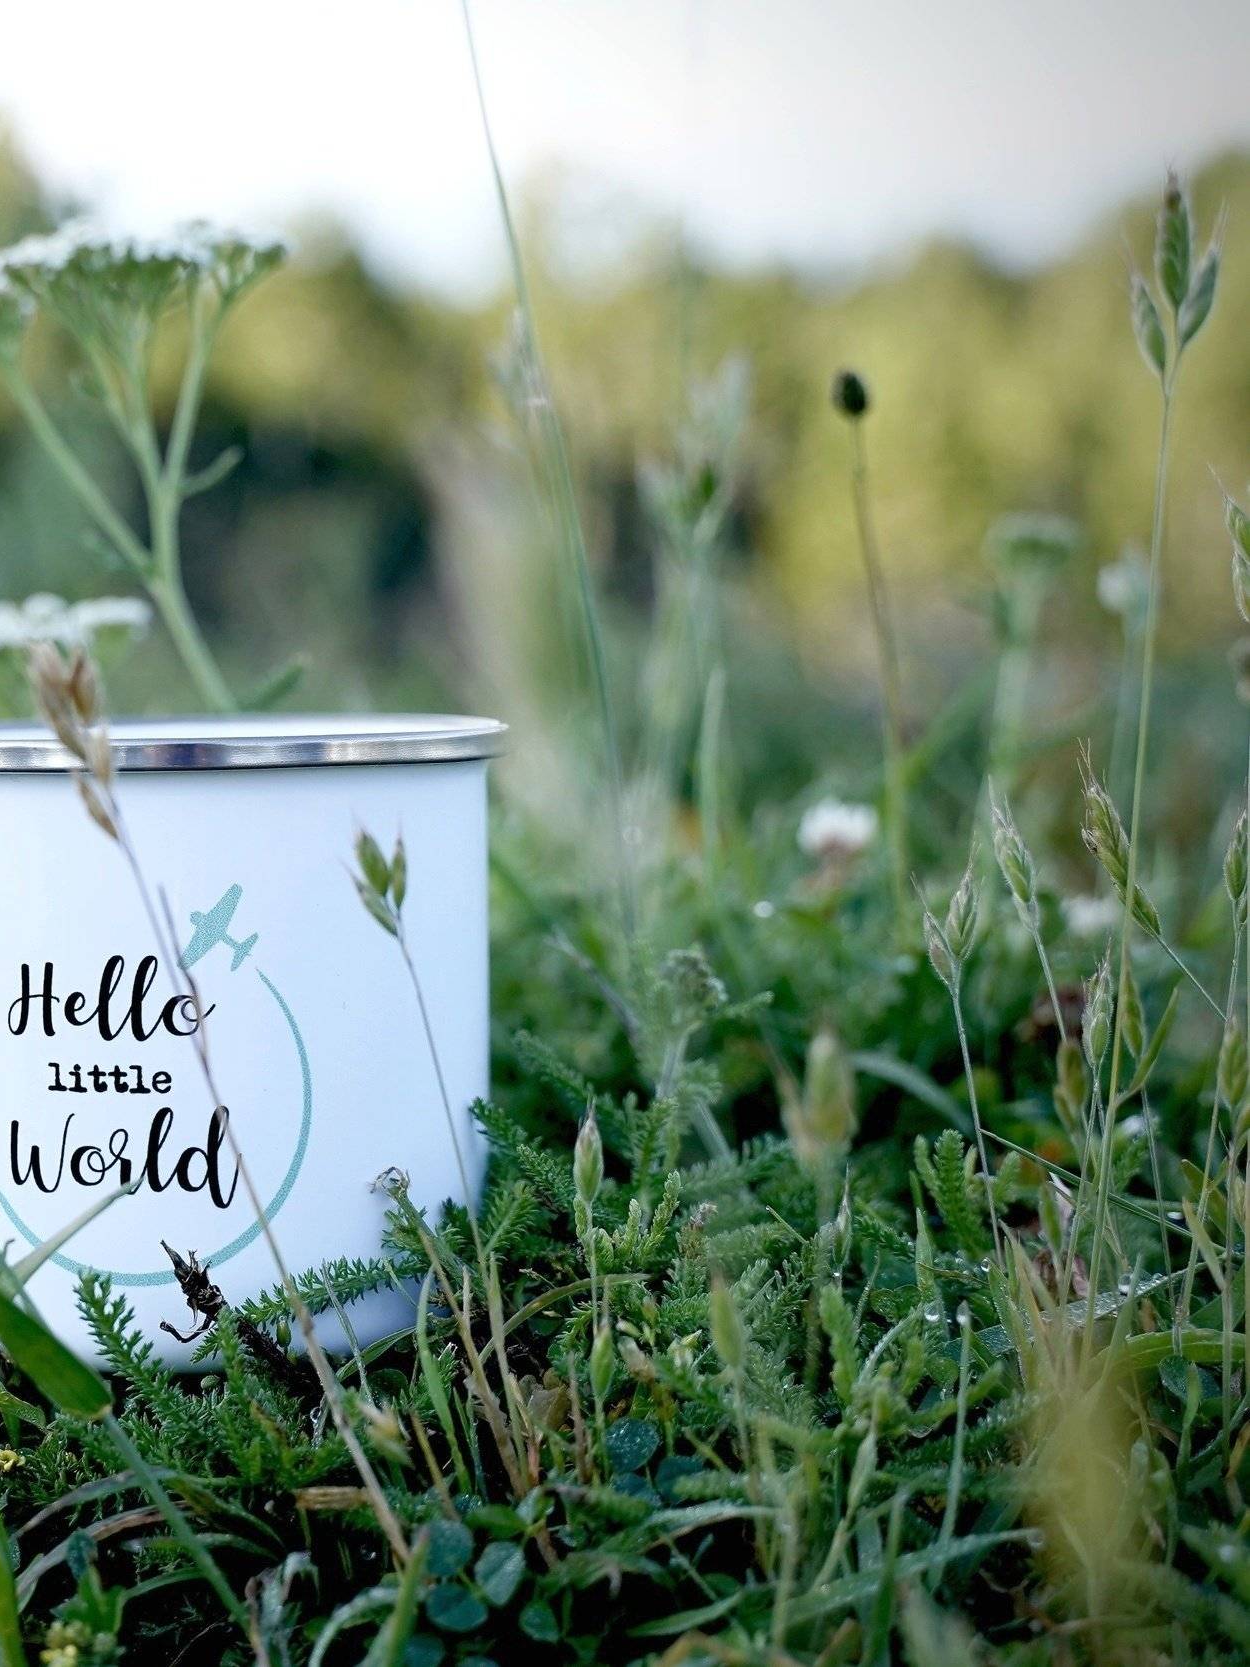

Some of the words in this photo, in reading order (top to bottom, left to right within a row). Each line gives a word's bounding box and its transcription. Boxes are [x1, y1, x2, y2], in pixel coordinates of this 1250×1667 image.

[8, 955, 216, 1041] Hello
[48, 1062, 172, 1094] little
[10, 1105, 243, 1209] World
